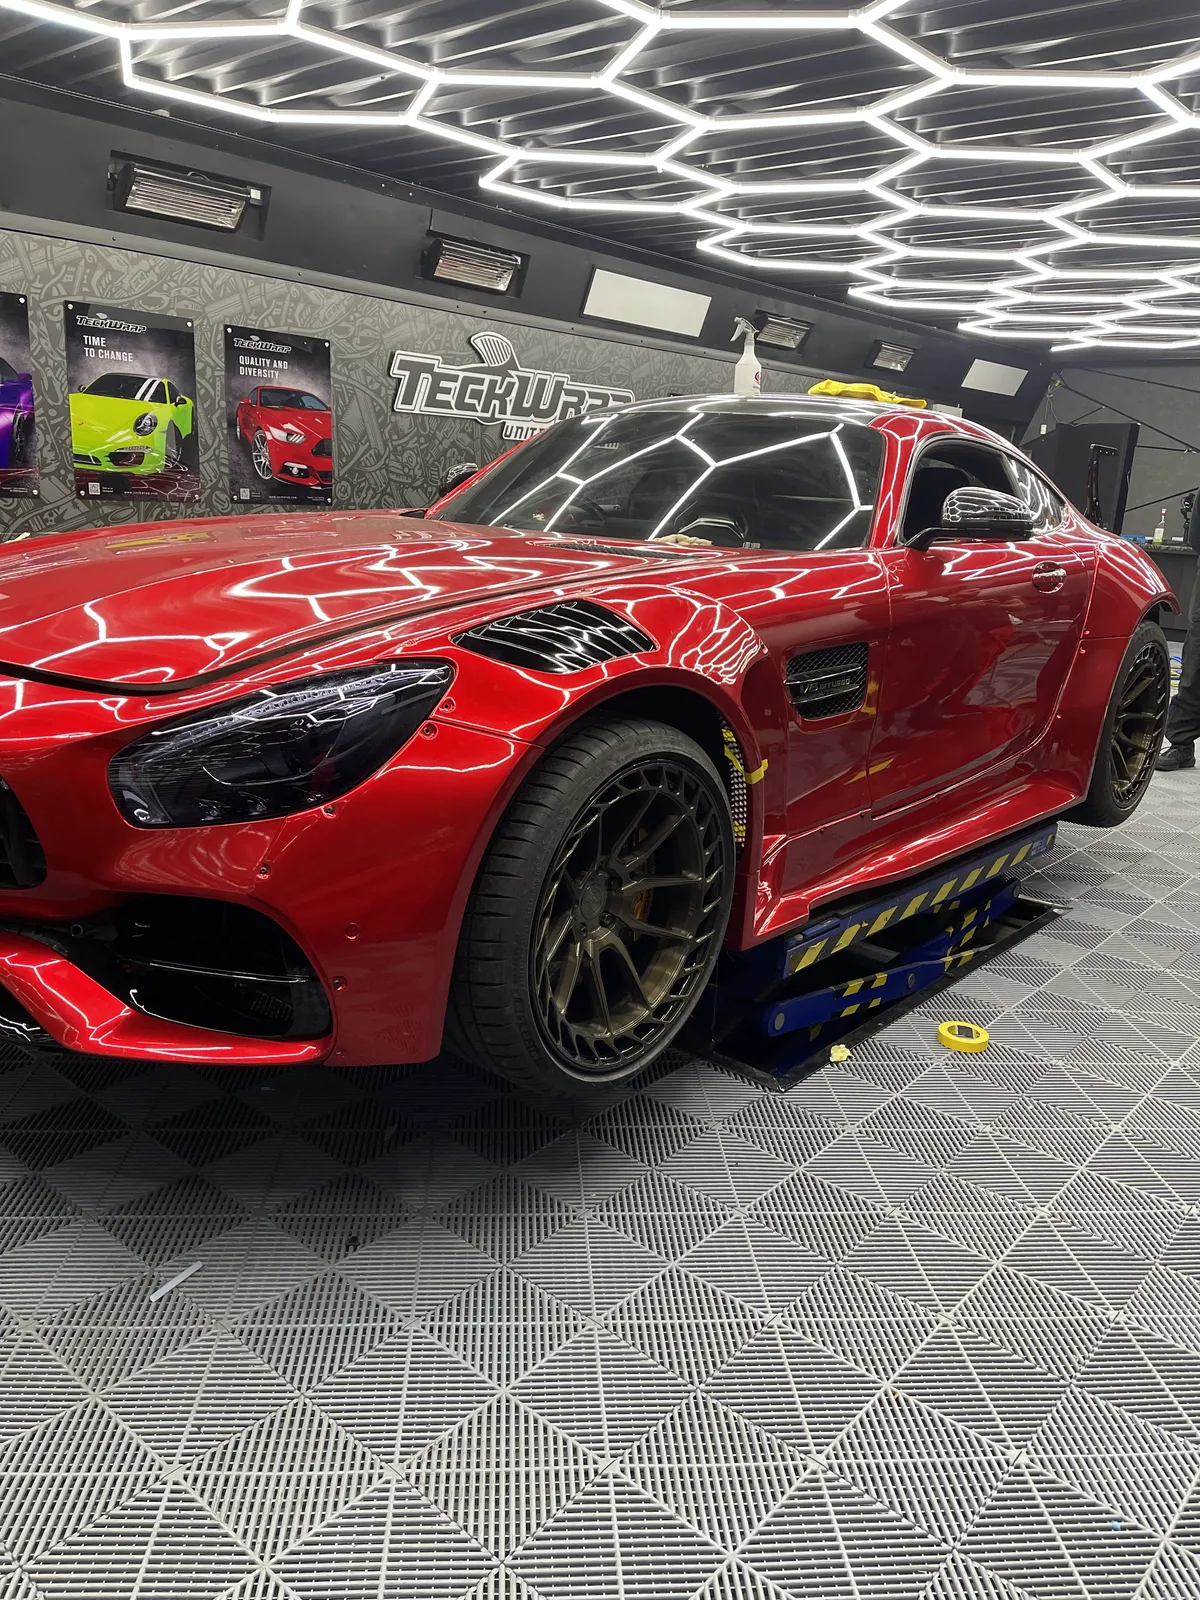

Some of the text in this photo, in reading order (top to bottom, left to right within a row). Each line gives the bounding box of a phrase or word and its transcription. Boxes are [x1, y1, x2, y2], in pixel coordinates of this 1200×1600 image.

[76, 315, 147, 334] TECKWRAP
[83, 335, 106, 347] TIME
[233, 337, 292, 354] TECKWRAP
[84, 347, 133, 362] TO CHANGE
[239, 355, 288, 370] QUALITY AND
[239, 366, 280, 379] DIVERSITY
[391, 353, 634, 423] TECKWRA
[504, 425, 546, 440] UNIT
